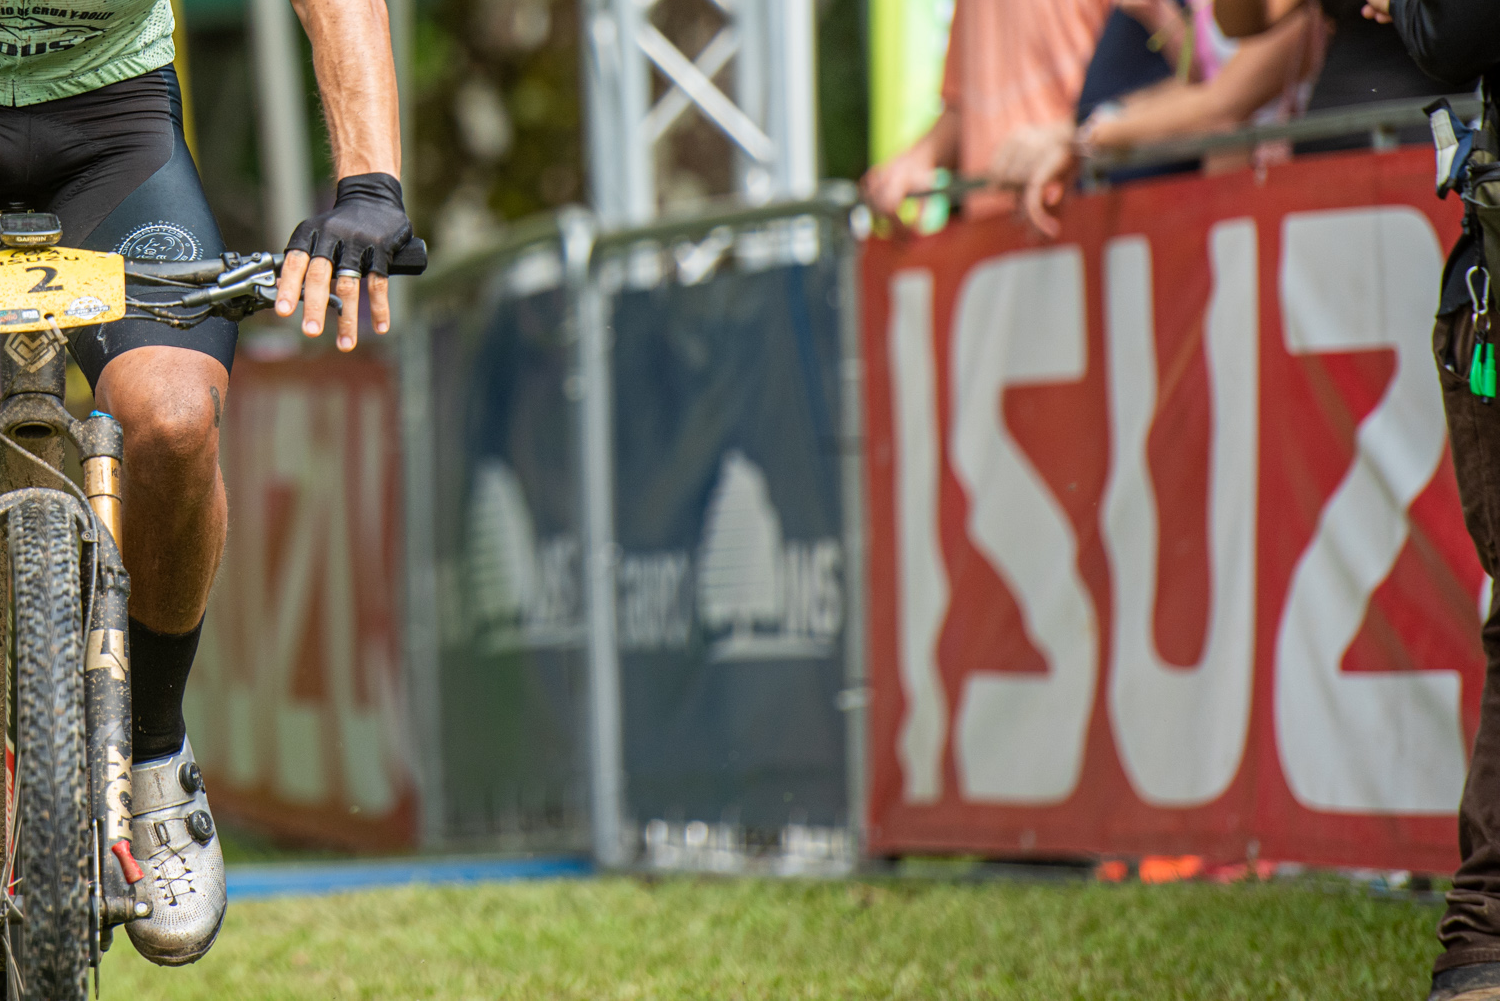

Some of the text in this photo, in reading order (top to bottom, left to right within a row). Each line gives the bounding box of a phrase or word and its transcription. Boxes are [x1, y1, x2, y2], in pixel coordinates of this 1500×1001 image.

[17, 6, 29, 17] DE
[31, 6, 68, 18] GRUA
[133, 228, 184, 240] SANTOS
[24, 265, 65, 294] 2
[890, 205, 1468, 816] ISUZ
[106, 745, 133, 840] FOX
